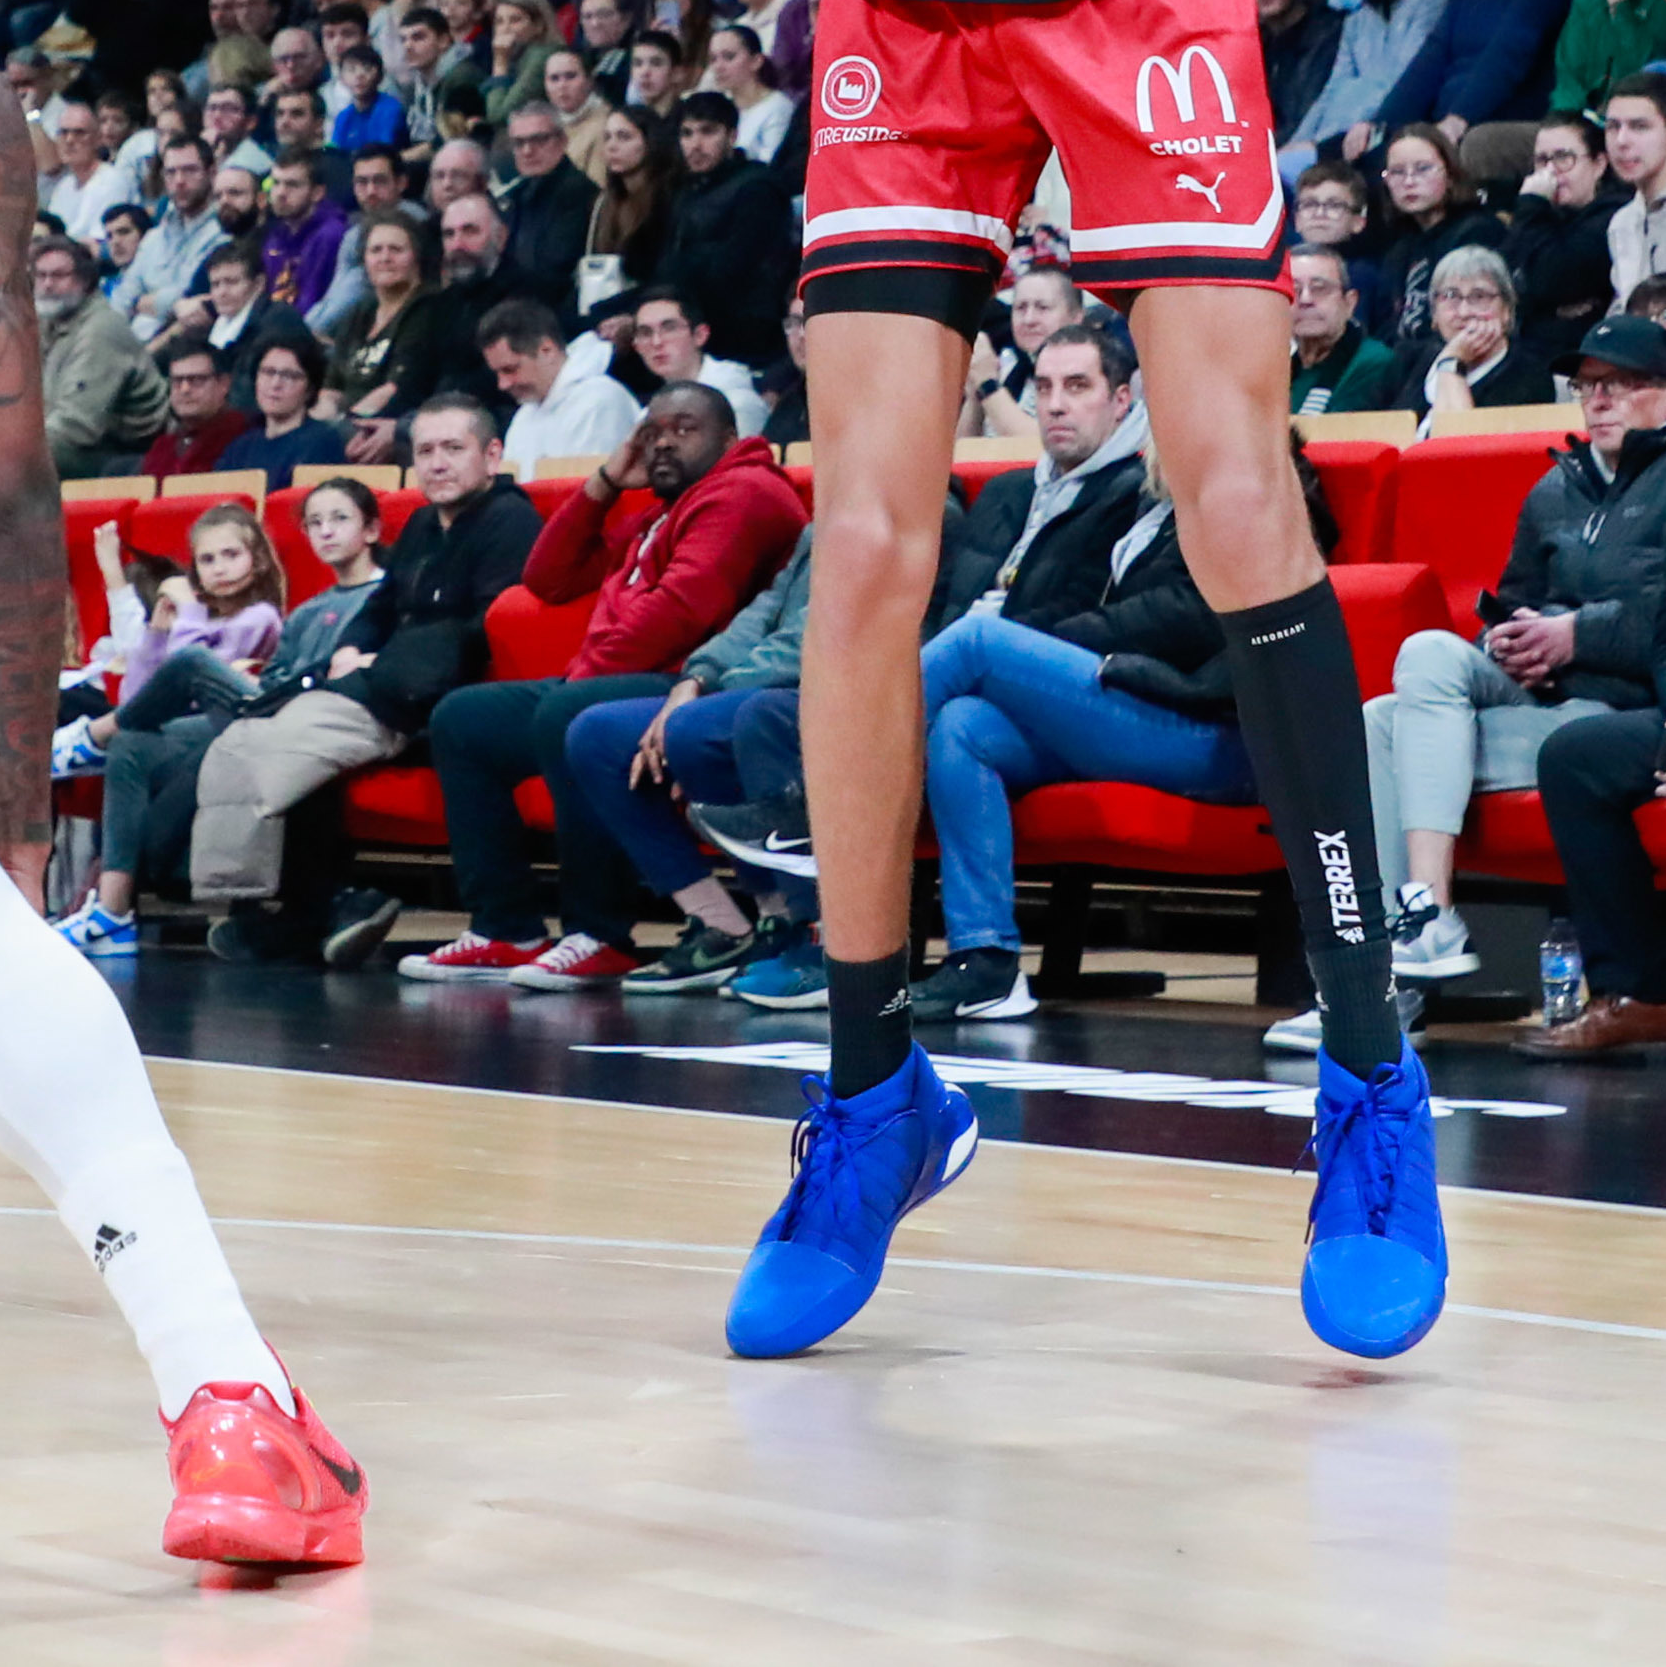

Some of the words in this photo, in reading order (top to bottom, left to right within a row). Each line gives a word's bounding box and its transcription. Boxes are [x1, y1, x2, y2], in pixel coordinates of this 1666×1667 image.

[1149, 135, 1243, 155] CHOLET
[1250, 622, 1306, 646] AEROREADY
[1313, 829, 1363, 927] TERREX
